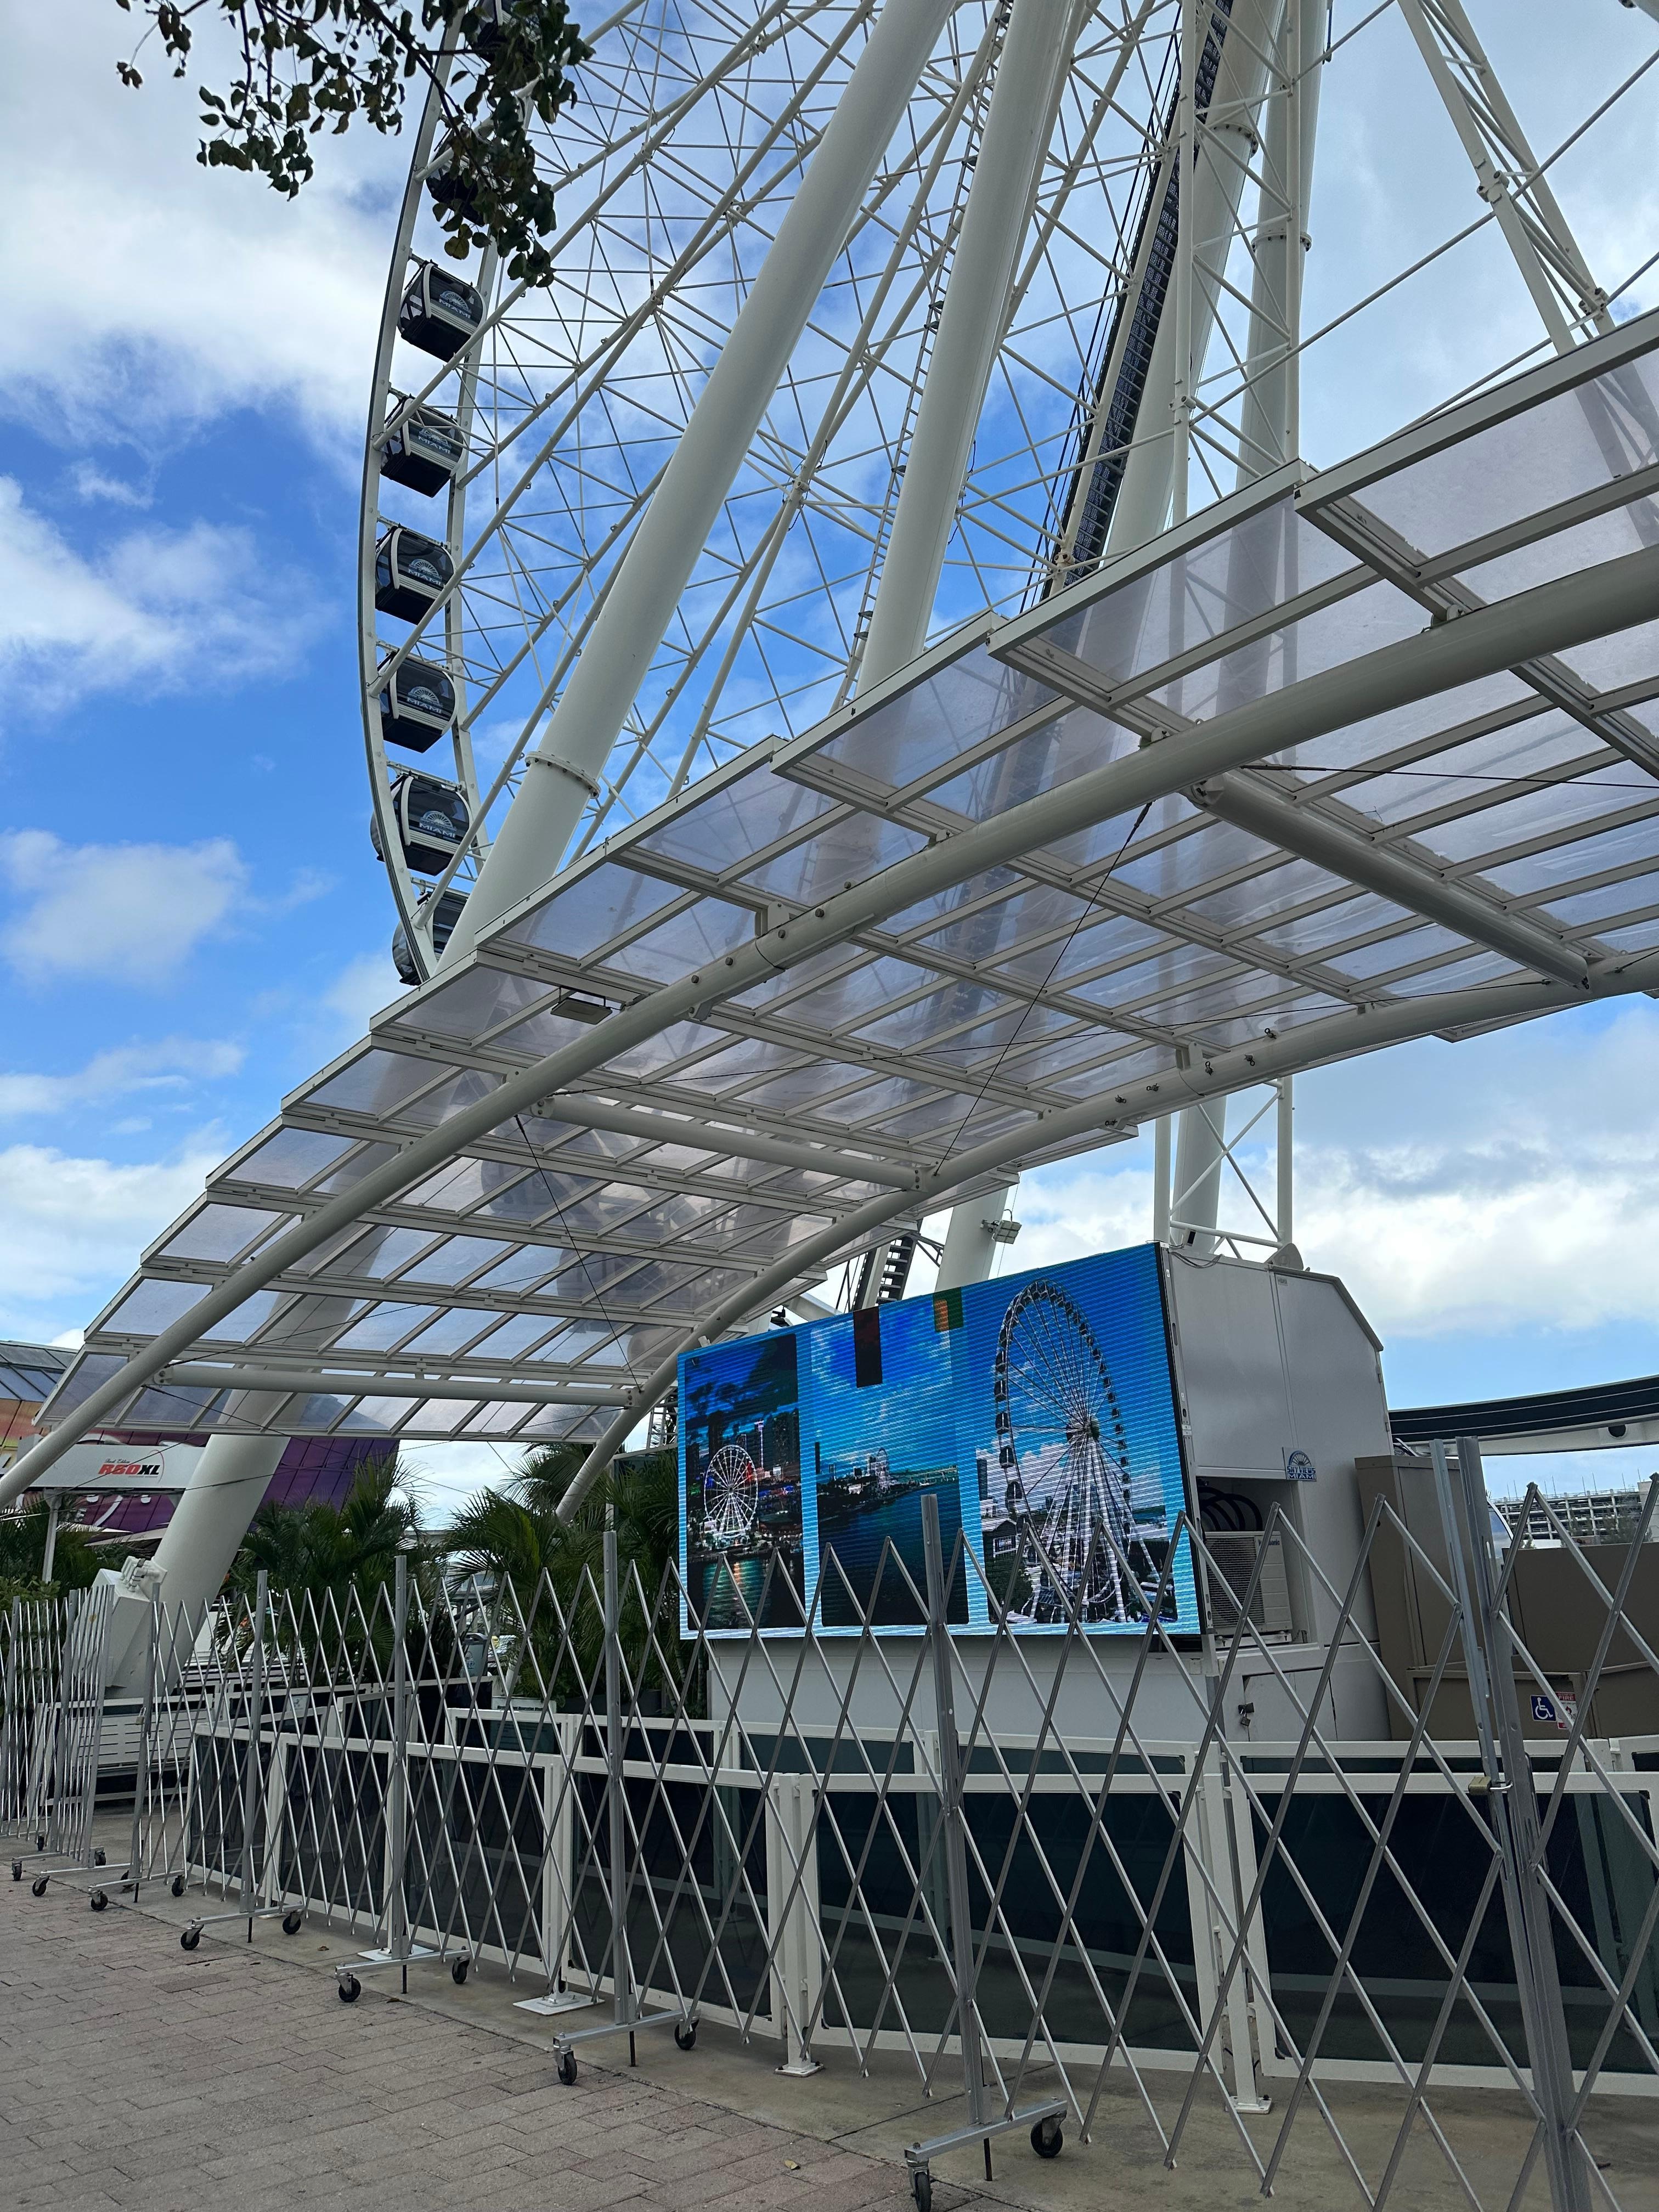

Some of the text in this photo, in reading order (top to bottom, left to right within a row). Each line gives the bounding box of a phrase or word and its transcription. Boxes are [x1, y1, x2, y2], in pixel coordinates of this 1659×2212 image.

[439, 298, 471, 318] MIAMI
[418, 436, 450, 454] MIAMI
[408, 568, 441, 585] MIAMI
[407, 697, 441, 713] MIAMI
[419, 823, 455, 838] MIAMI
